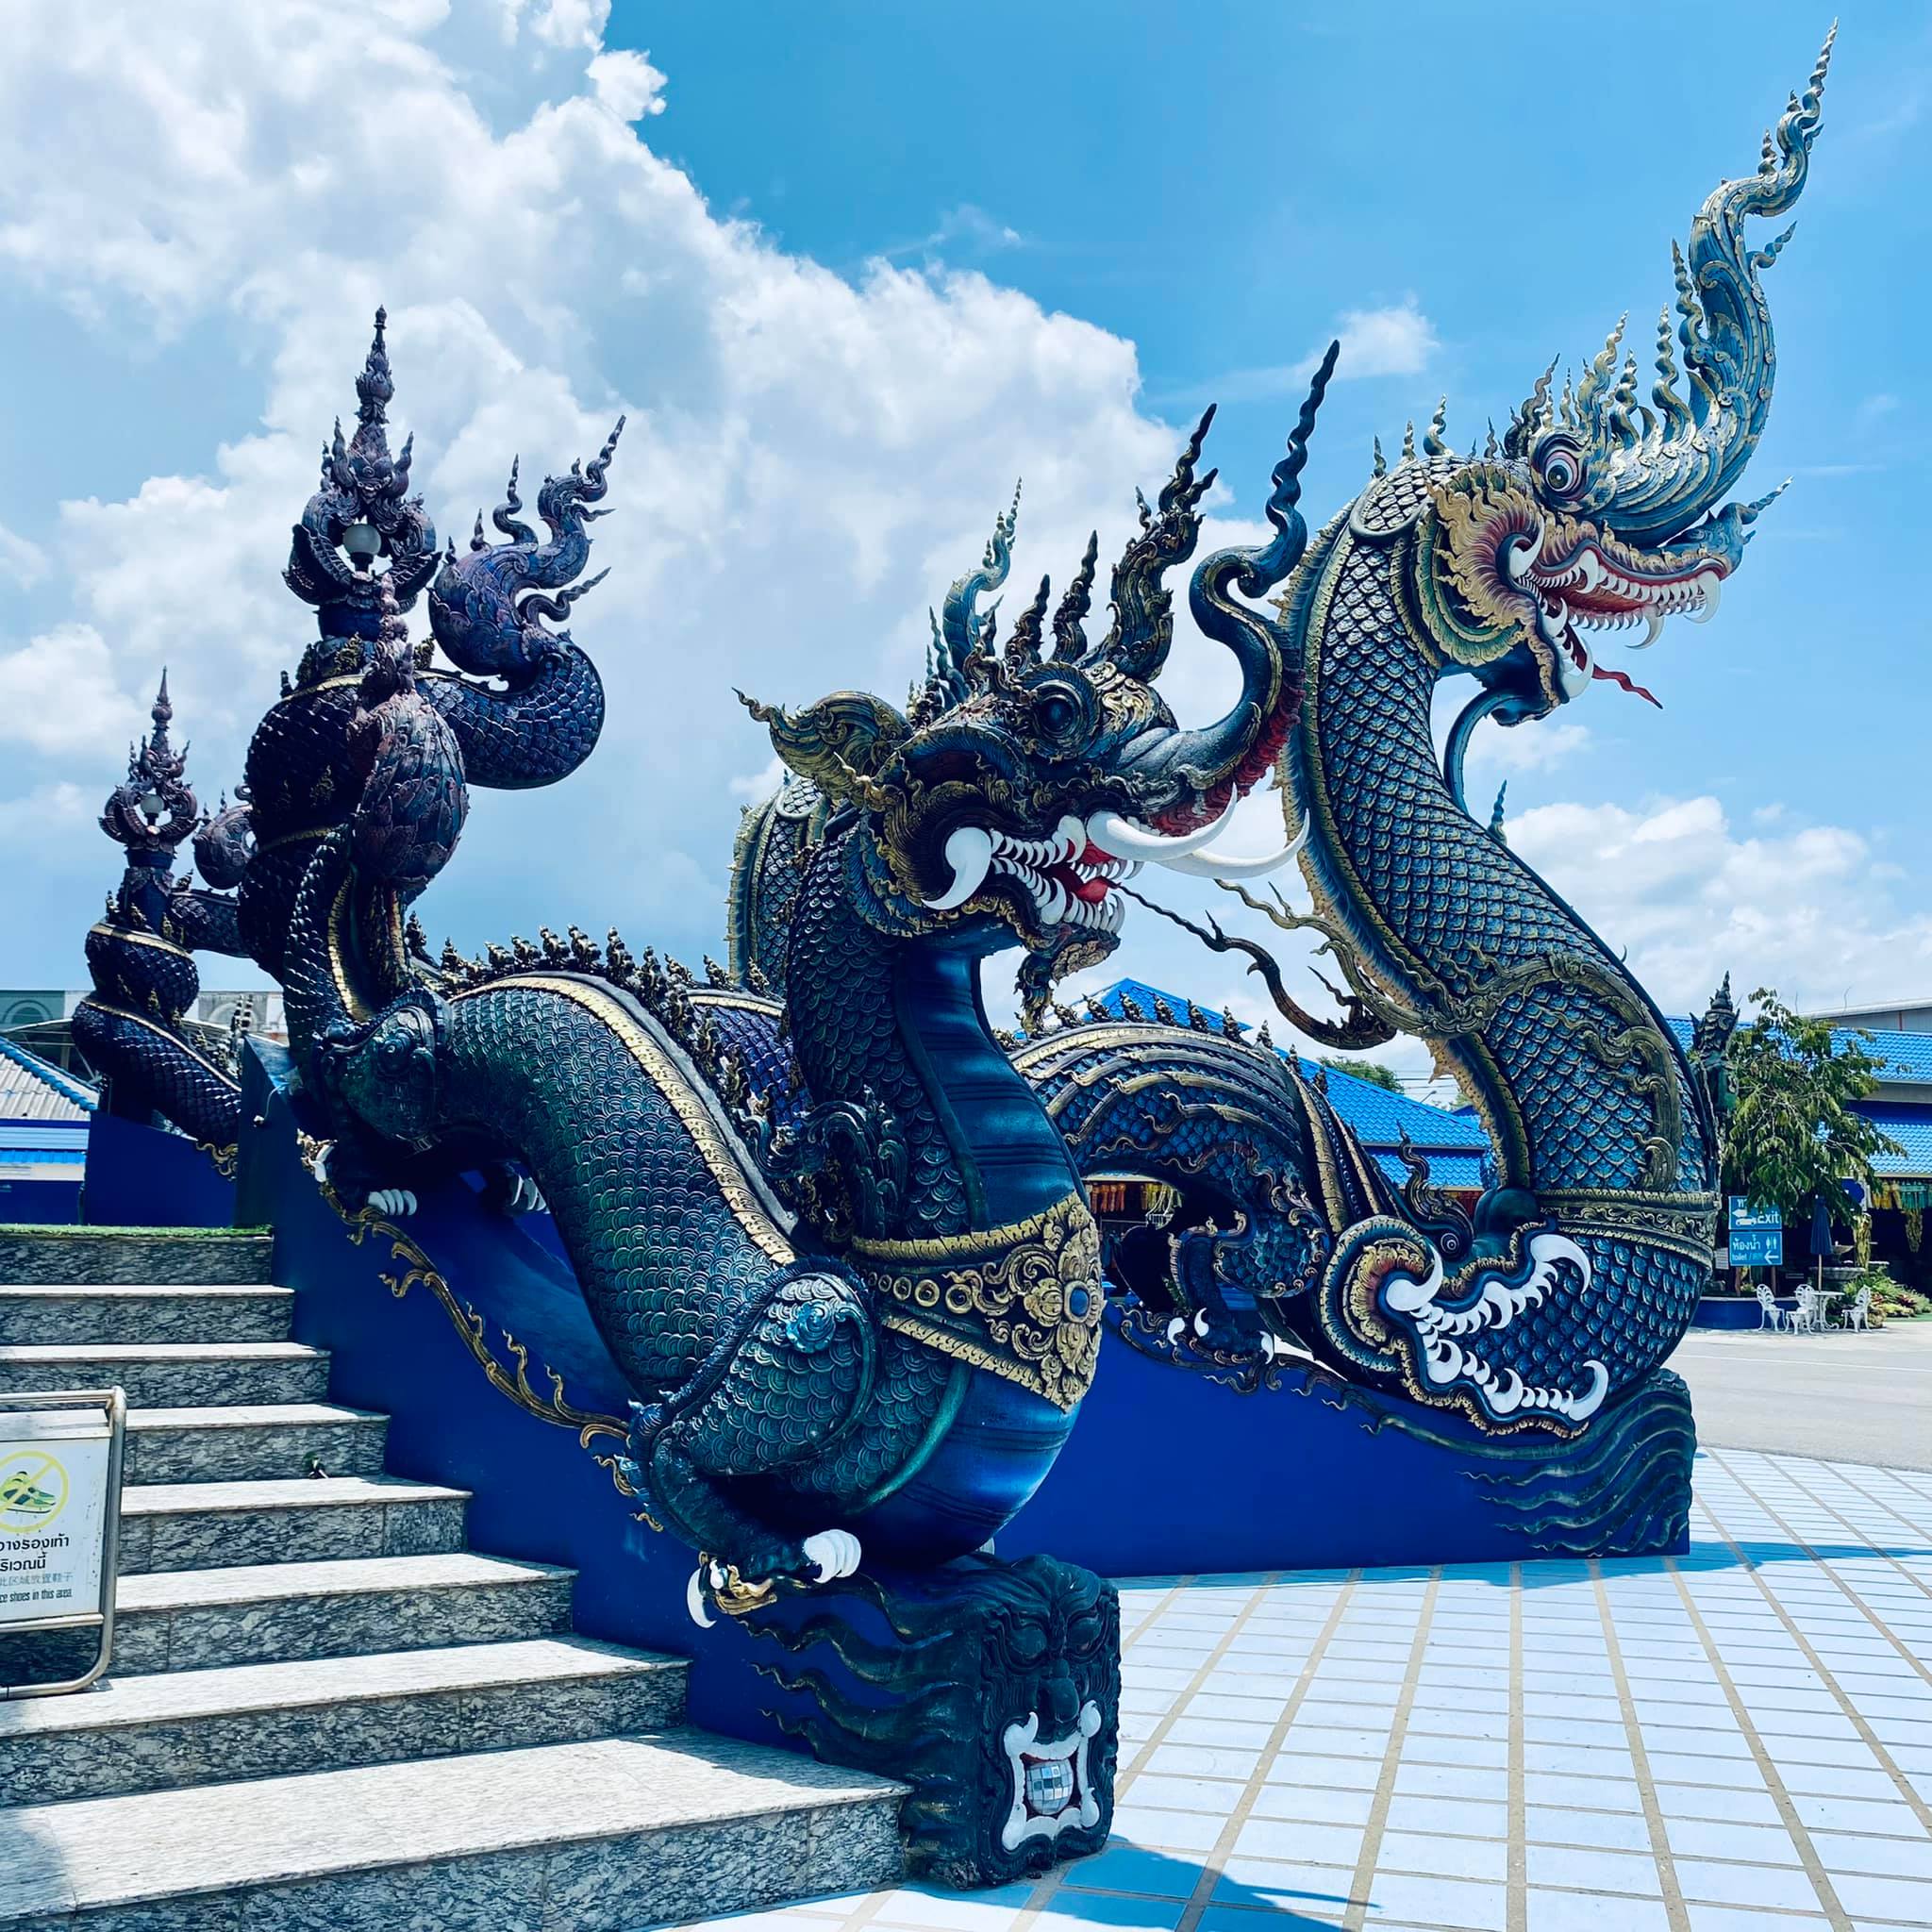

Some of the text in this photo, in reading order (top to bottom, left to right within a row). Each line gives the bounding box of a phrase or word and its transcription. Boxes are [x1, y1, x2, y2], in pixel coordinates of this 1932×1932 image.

[1757, 1210, 1780, 1224] Exit
[1732, 1234, 1761, 1251] ห้องน้ำ
[9, 1591, 30, 1602] shoes
[32, 1589, 40, 1600] in
[42, 1588, 55, 1600] this
